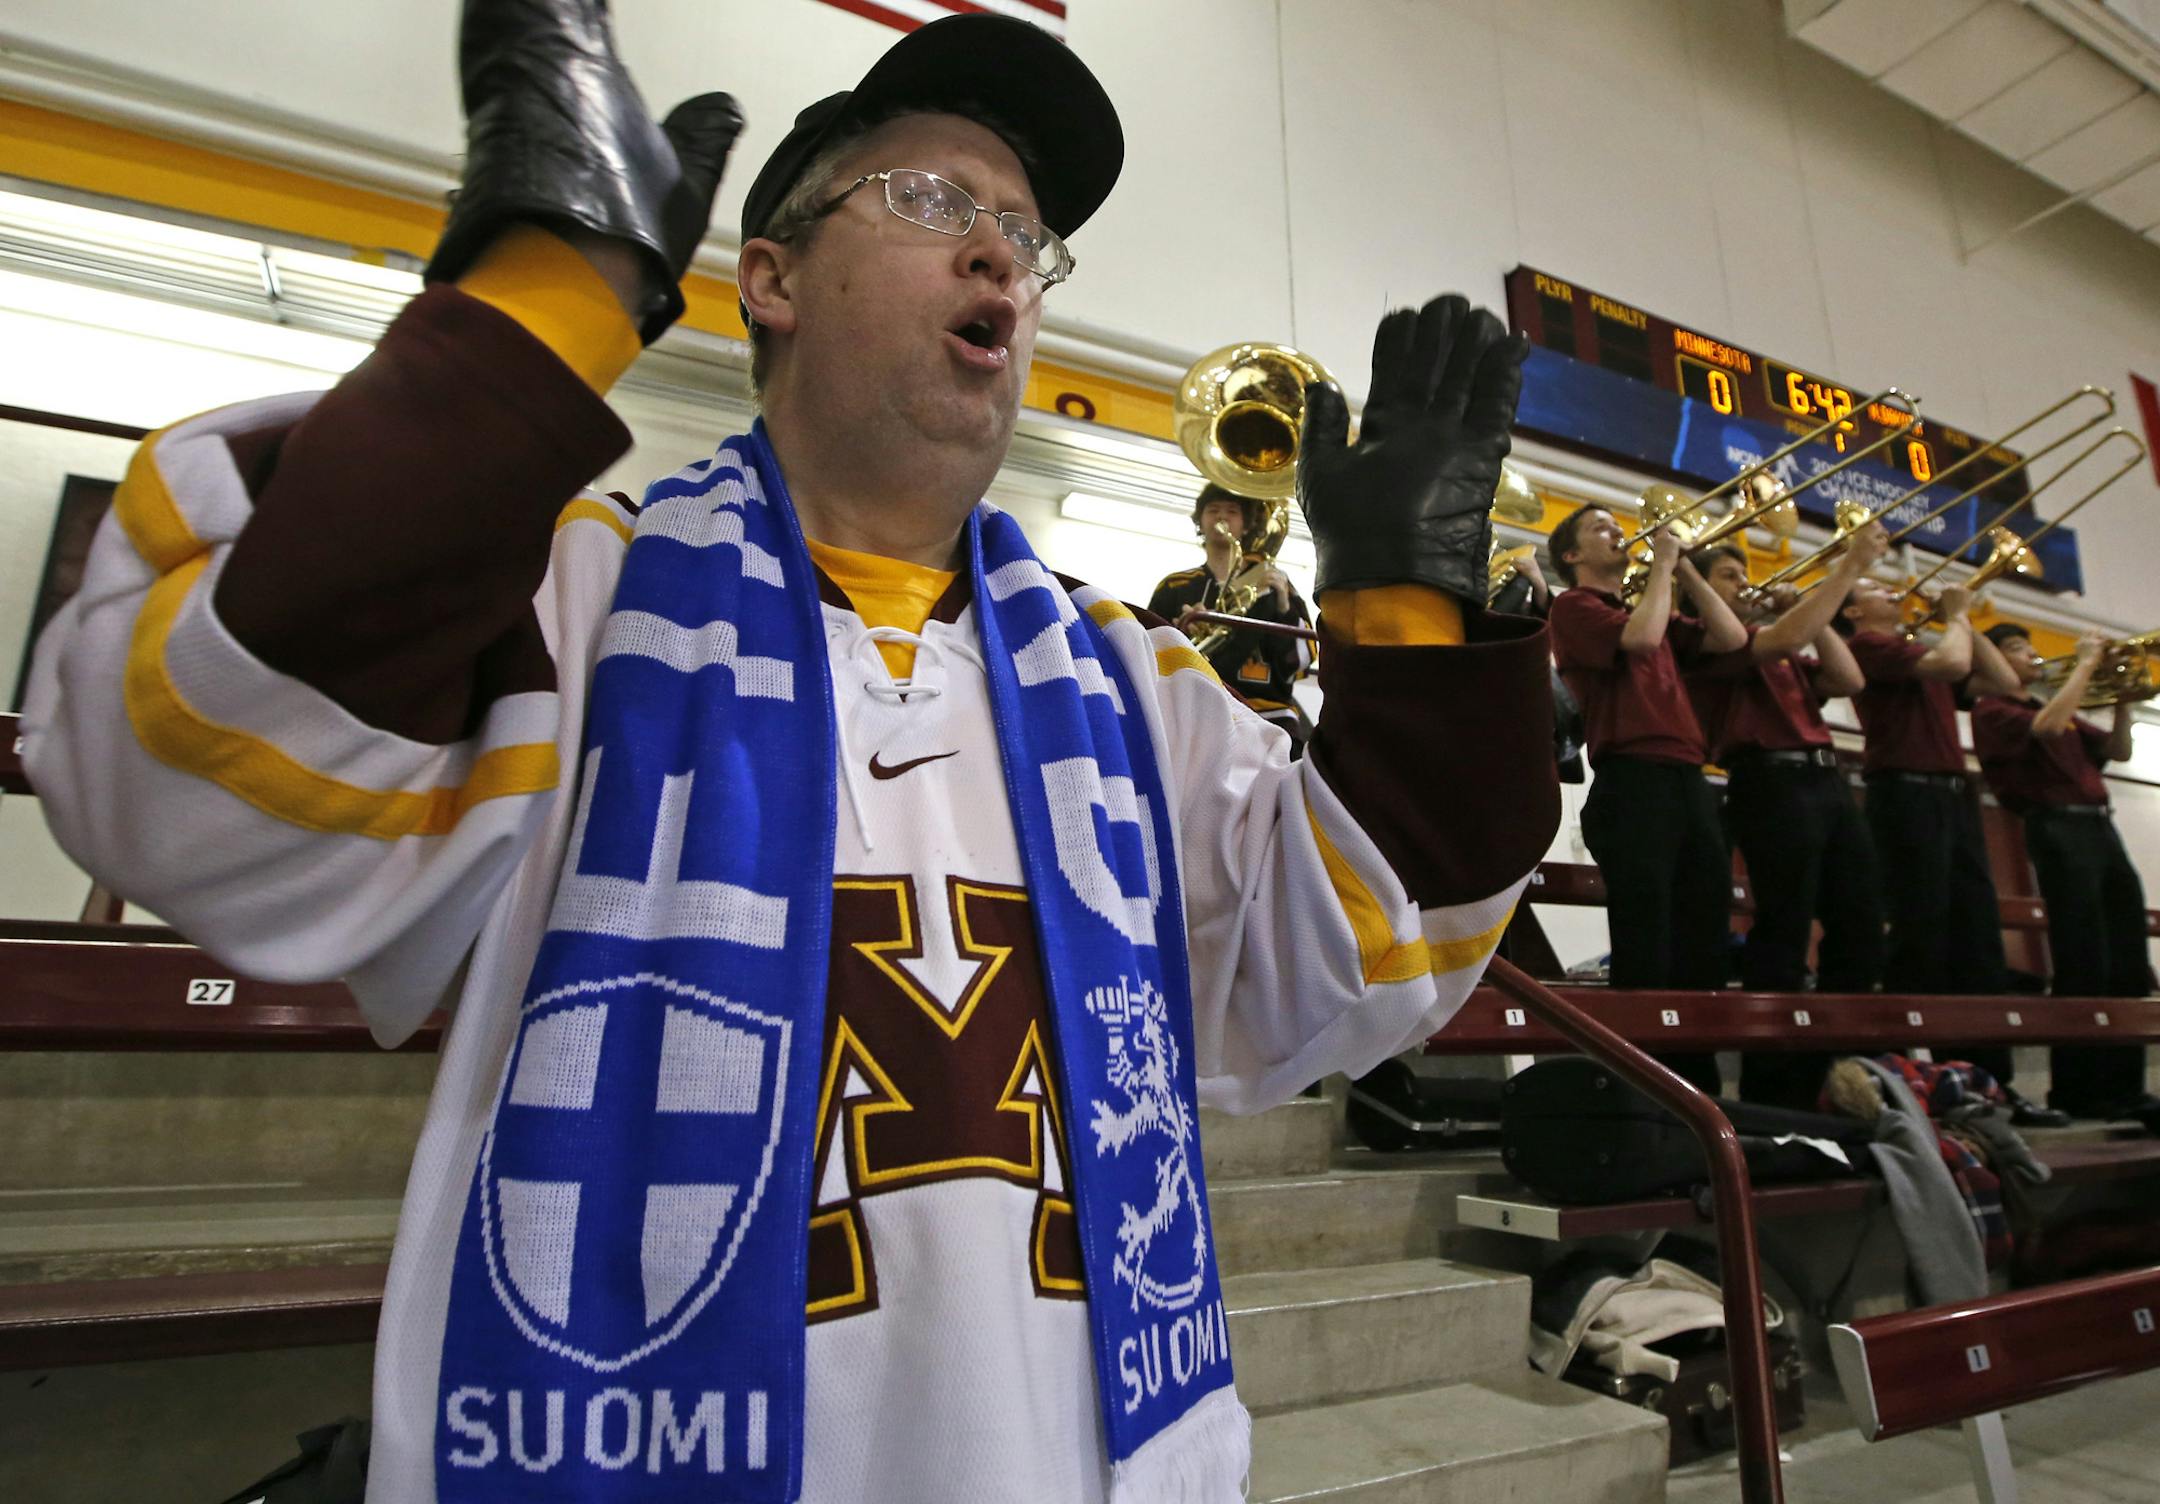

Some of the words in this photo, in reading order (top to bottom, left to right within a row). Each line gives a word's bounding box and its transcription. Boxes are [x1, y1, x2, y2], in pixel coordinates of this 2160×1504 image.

[1534, 273, 1573, 302] PLYR
[1590, 294, 1648, 331] PENALTY
[1673, 328, 1751, 375] MINNESOTA
[1707, 369, 1732, 416] 0
[1786, 371, 1853, 431] 6:42
[1907, 440, 1931, 482] 0
[1844, 470, 1872, 492] ICE
[192, 982, 231, 1002] 27
[1666, 1011, 1674, 1024] 2
[1501, 1209, 1510, 1226] 8
[2138, 1310, 2149, 1330] 2
[1118, 1299, 1228, 1416] SUOMI
[1973, 1348, 1983, 1369] 1
[446, 1385, 768, 1474] SUOMI
